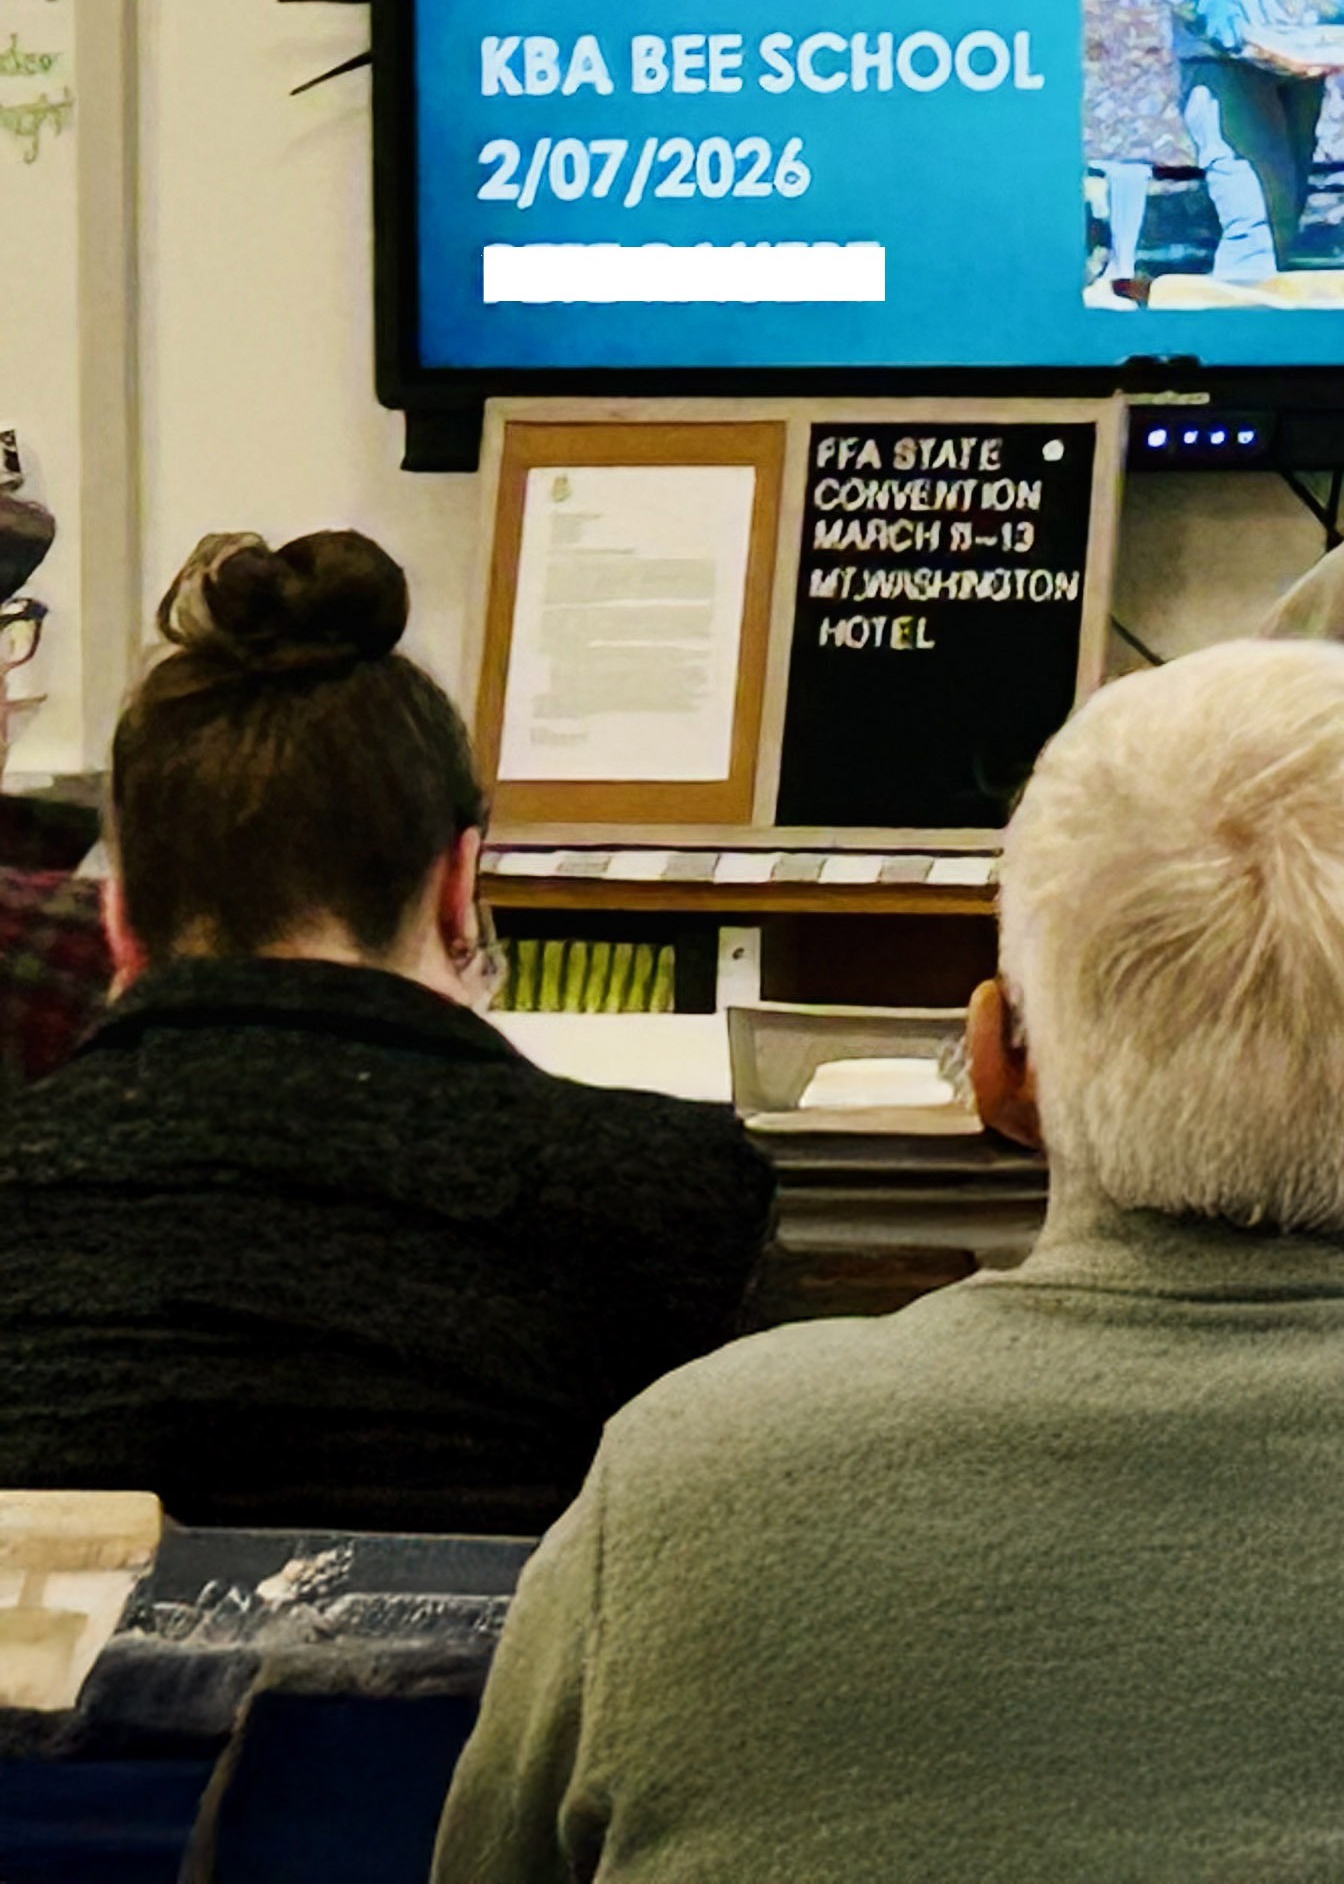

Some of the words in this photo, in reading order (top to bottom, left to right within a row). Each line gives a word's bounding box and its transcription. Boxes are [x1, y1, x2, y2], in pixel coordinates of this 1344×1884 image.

[481, 35, 613, 95] KBA
[631, 34, 743, 94] BEE
[759, 31, 1044, 93] SCHOOL
[477, 137, 811, 209] 2/07/2026
[893, 437, 1001, 471] STATE
[813, 477, 1042, 512] CONVENTION
[813, 518, 942, 553] MARCH
[819, 614, 935, 650] HOTEL
